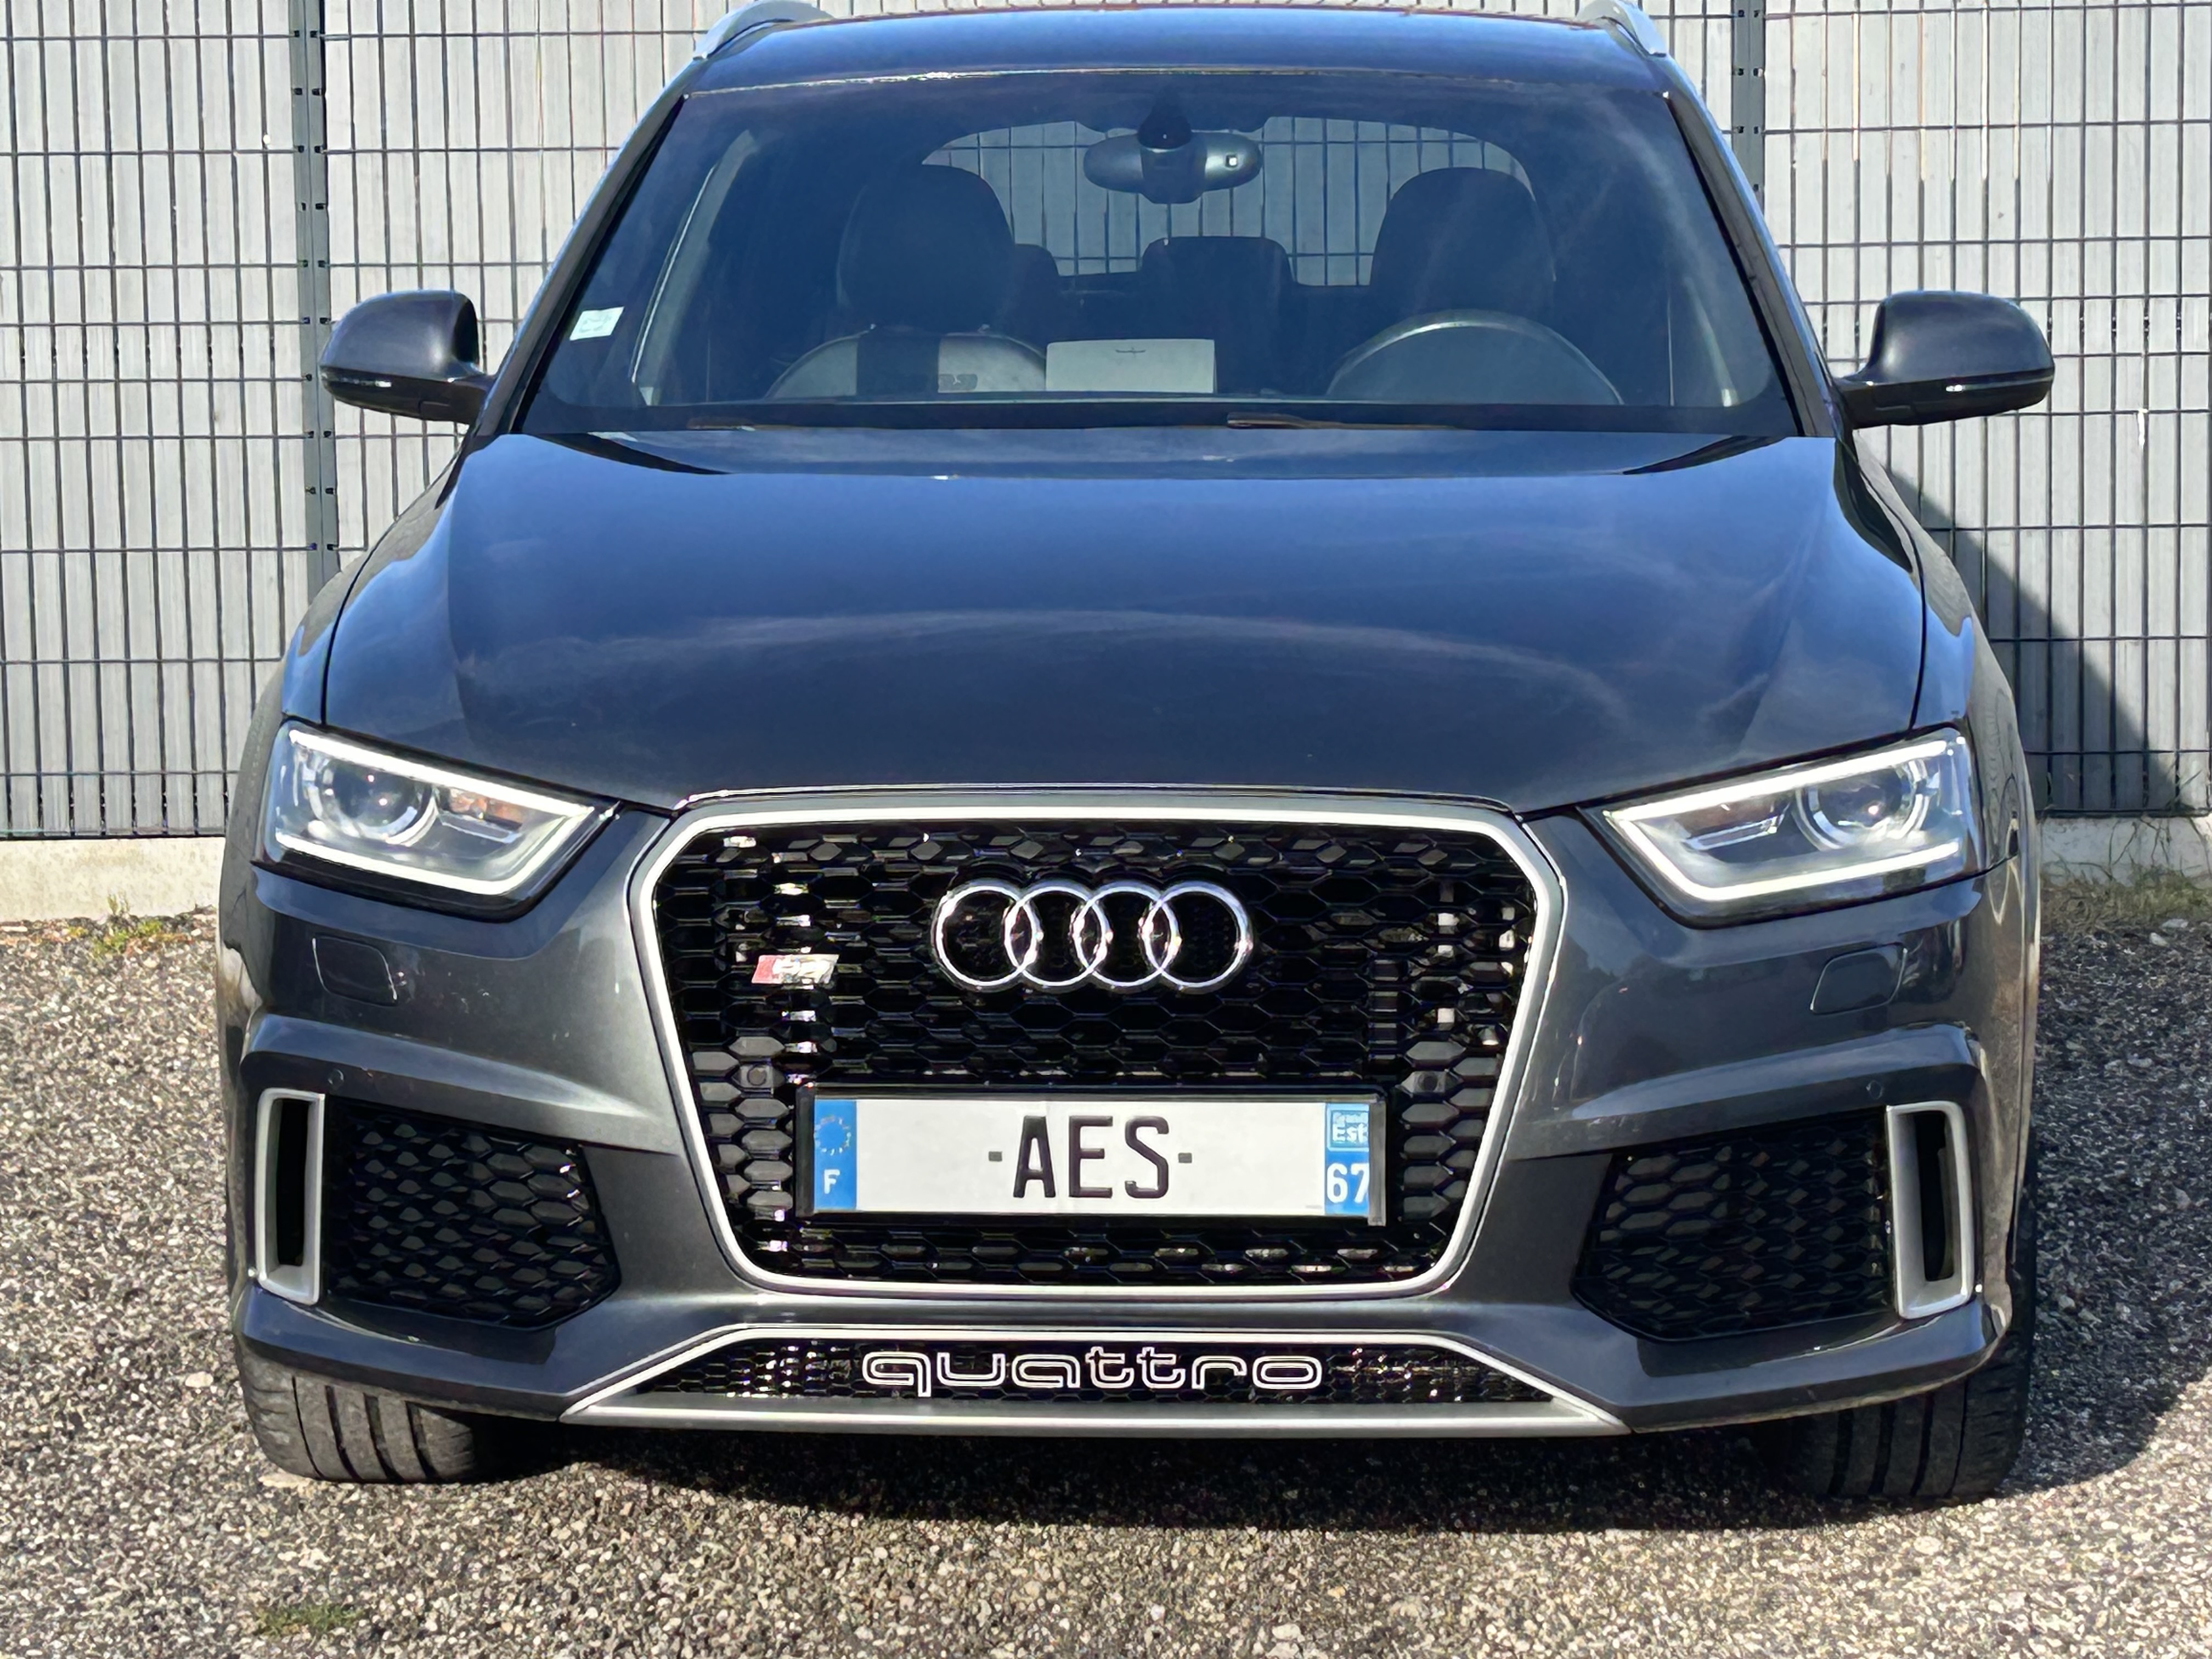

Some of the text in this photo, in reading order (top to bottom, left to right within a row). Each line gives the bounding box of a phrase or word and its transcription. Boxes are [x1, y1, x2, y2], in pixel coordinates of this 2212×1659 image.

[824, 1169, 840, 1194] F
[1327, 1163, 1369, 1203] 67
[862, 1346, 1323, 1398] quattro
